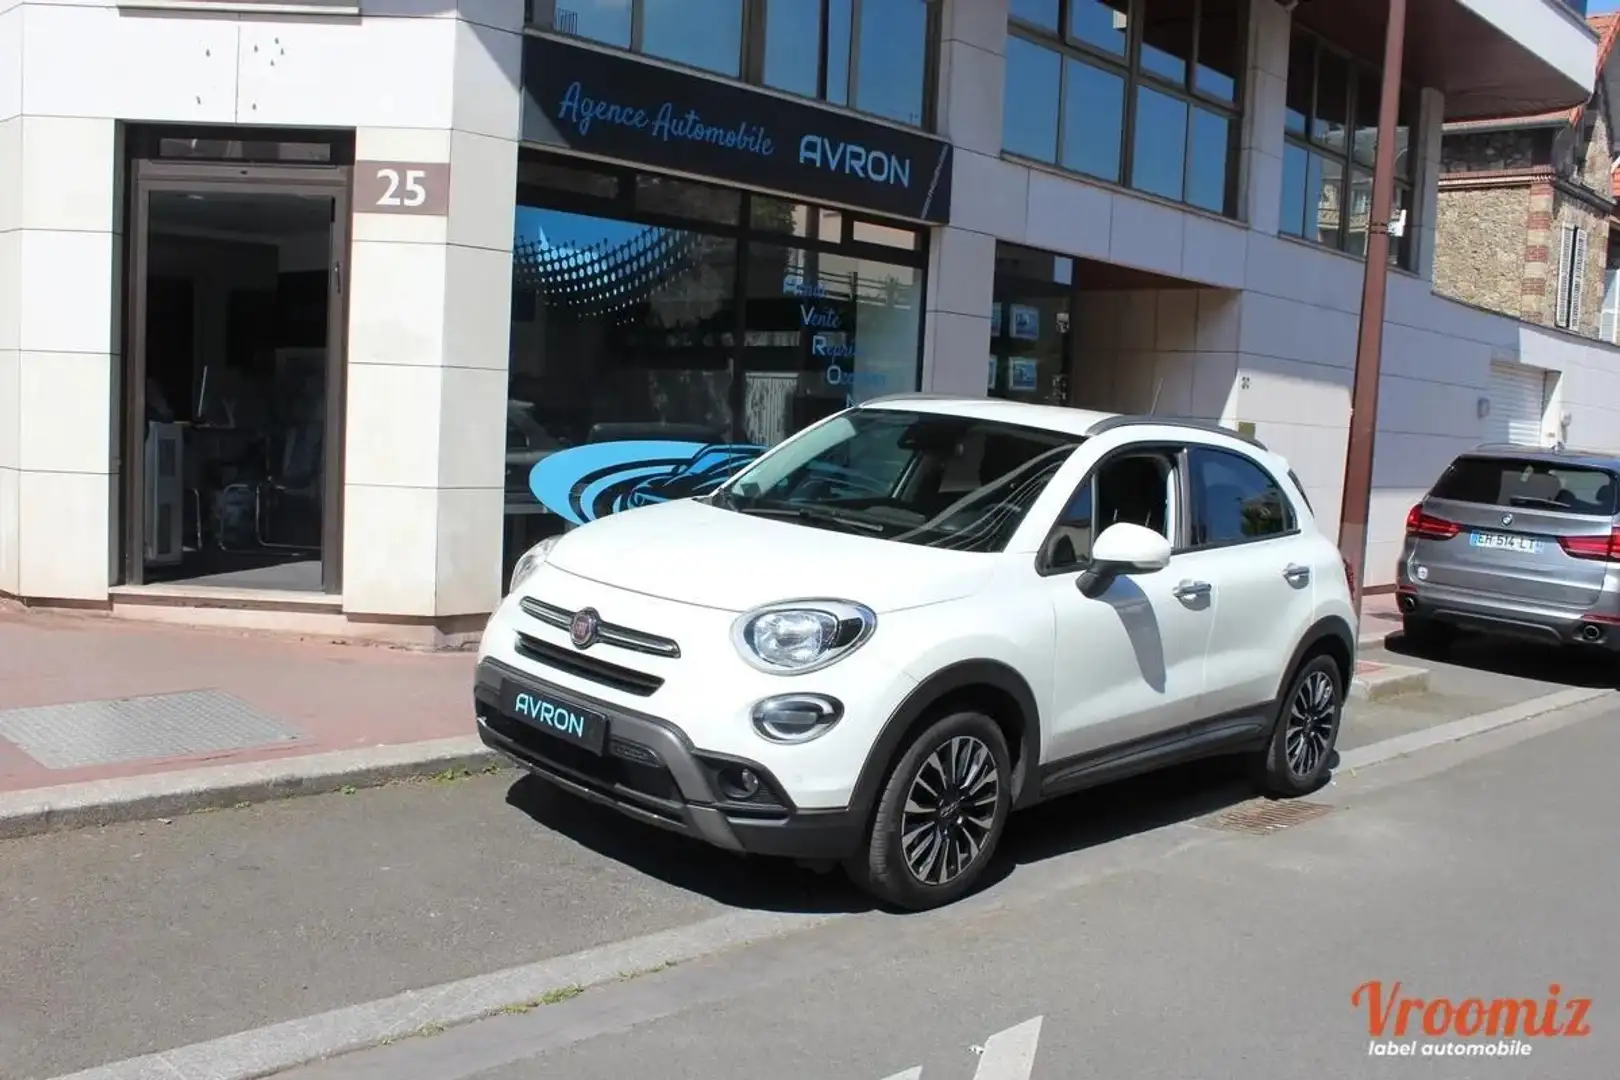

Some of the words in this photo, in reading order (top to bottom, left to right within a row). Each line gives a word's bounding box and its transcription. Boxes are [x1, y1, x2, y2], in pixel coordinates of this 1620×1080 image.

[558, 81, 649, 136] Agence
[651, 102, 775, 156] Automobile
[799, 134, 911, 188] AVRON
[376, 168, 426, 206] 25
[800, 303, 841, 329] Vente
[515, 693, 584, 738] AVRON
